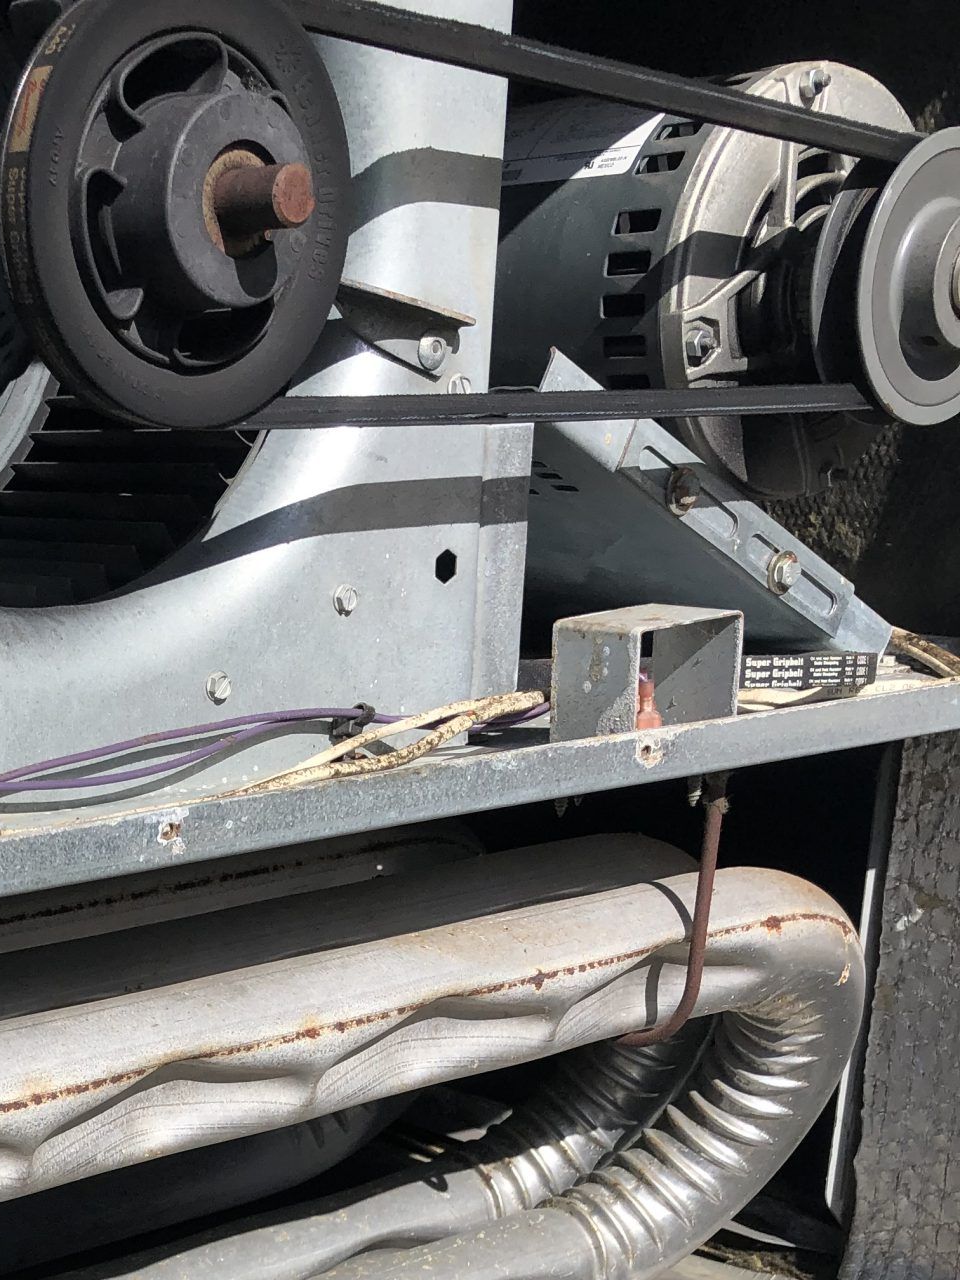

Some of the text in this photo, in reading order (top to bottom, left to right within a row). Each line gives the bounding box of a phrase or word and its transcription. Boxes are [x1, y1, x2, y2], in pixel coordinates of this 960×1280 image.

[745, 657, 772, 669] Super
[773, 656, 804, 668] Gripbelt
[744, 668, 771, 680] Super
[772, 668, 803, 680] Gripbelt
